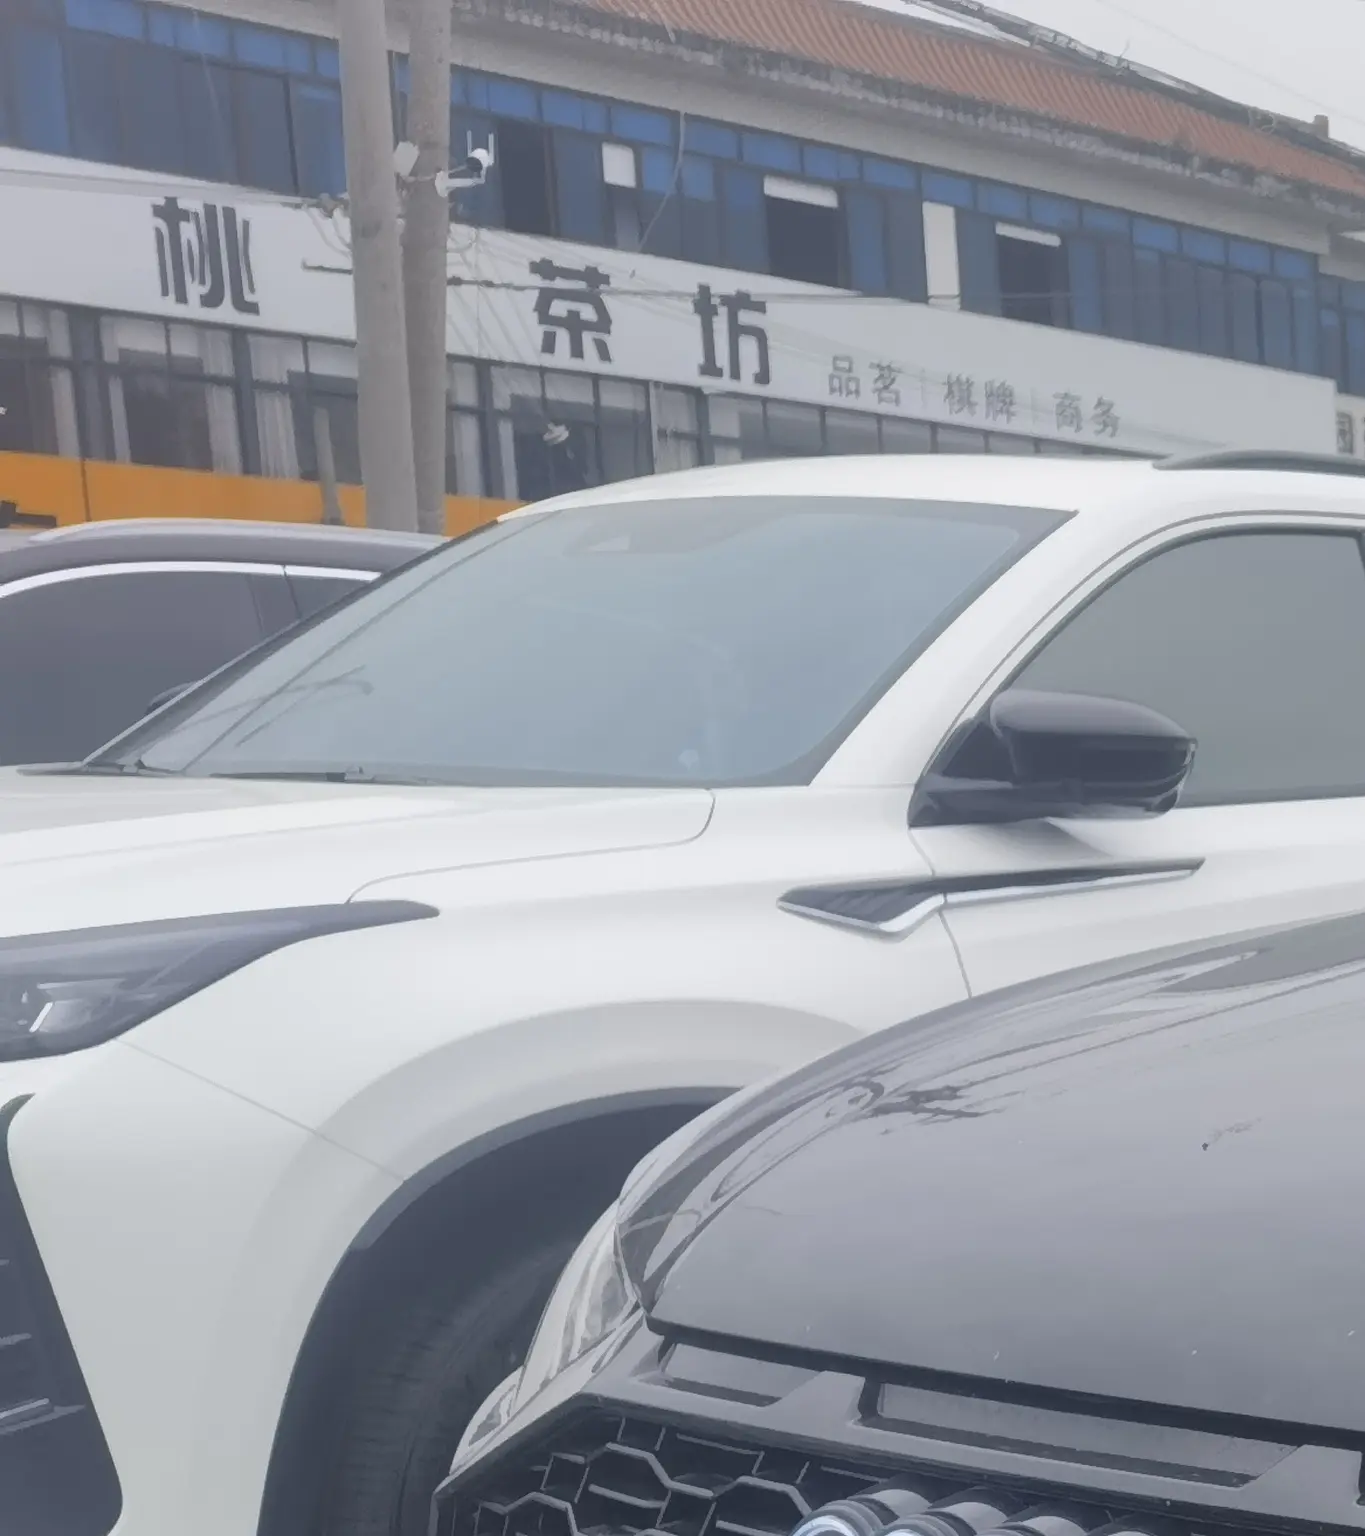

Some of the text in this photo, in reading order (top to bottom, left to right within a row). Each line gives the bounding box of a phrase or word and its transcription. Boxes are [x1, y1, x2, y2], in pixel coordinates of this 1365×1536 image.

[828, 354, 1121, 438] 品茗 棋牌 商务
